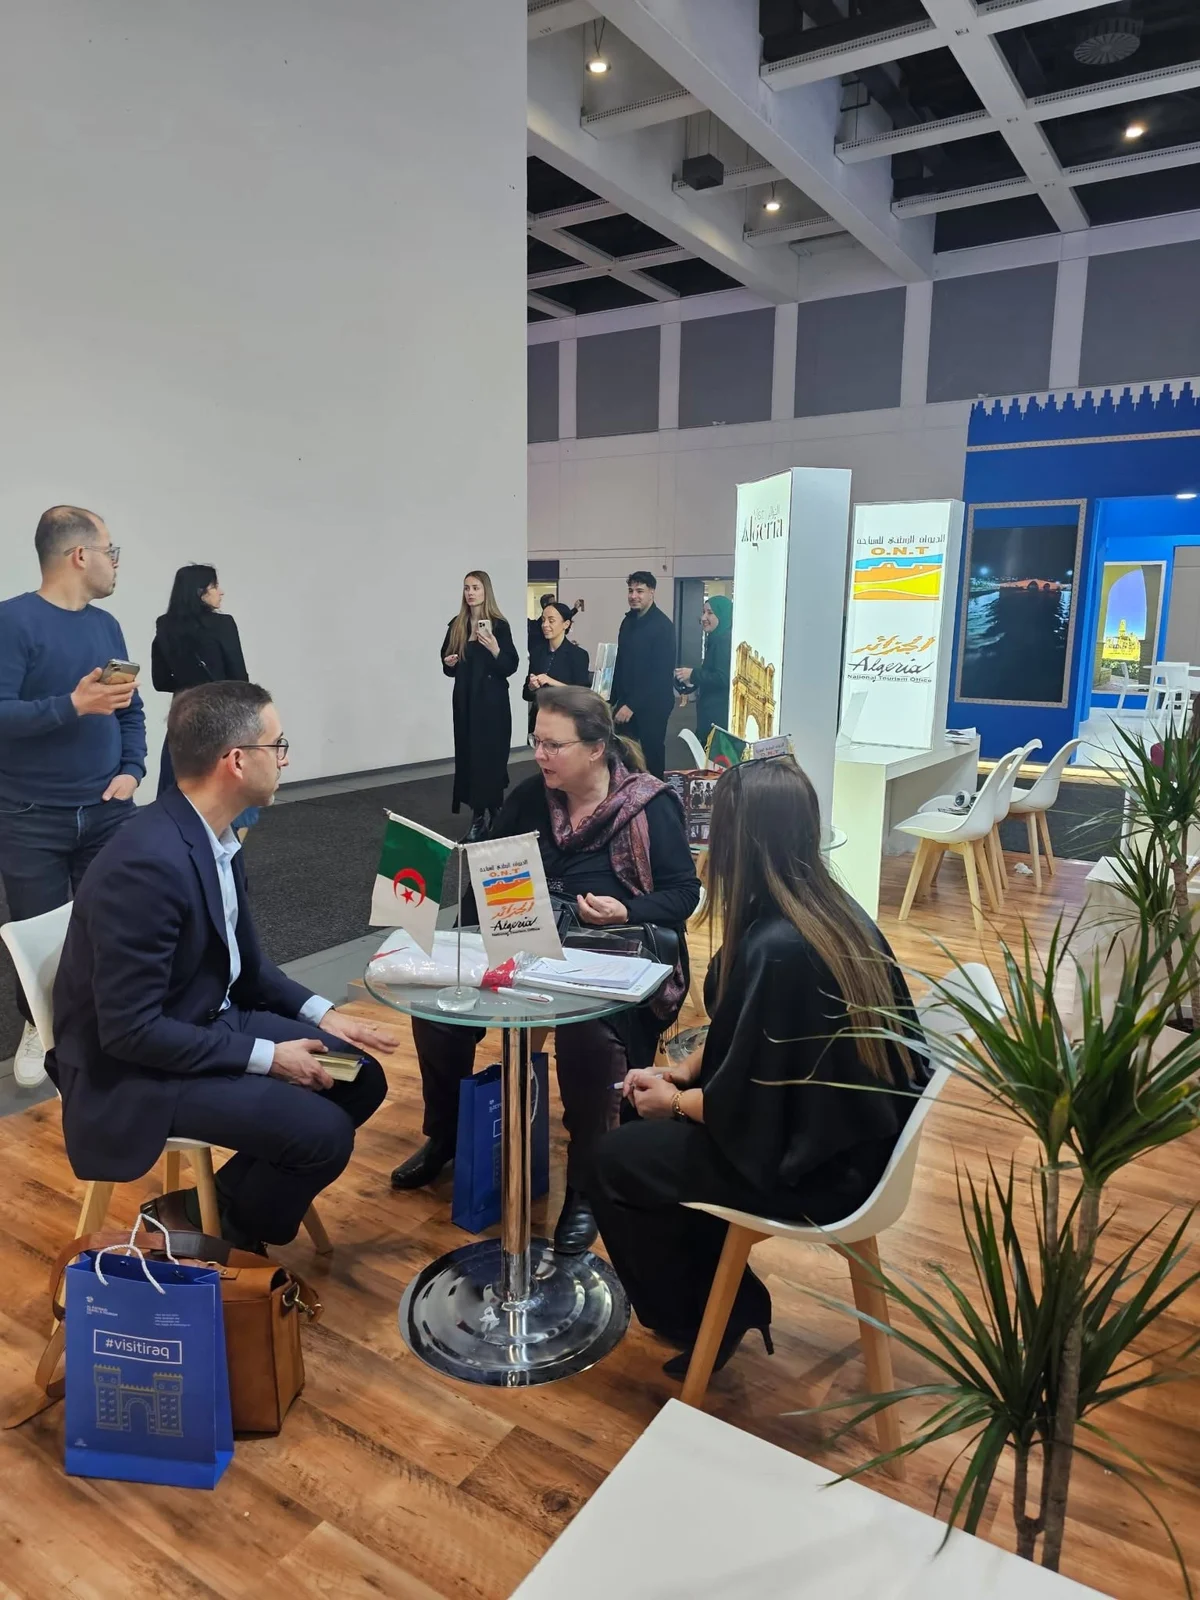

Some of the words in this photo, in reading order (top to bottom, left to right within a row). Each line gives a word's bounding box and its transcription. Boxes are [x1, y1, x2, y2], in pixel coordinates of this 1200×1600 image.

[741, 515, 783, 551] Algeria
[871, 546, 929, 556] O.N.T
[851, 635, 936, 656] الجزائر
[848, 656, 935, 682] Algeria
[490, 916, 538, 937] Algeria
[105, 1337, 170, 1360] #visitiraq
